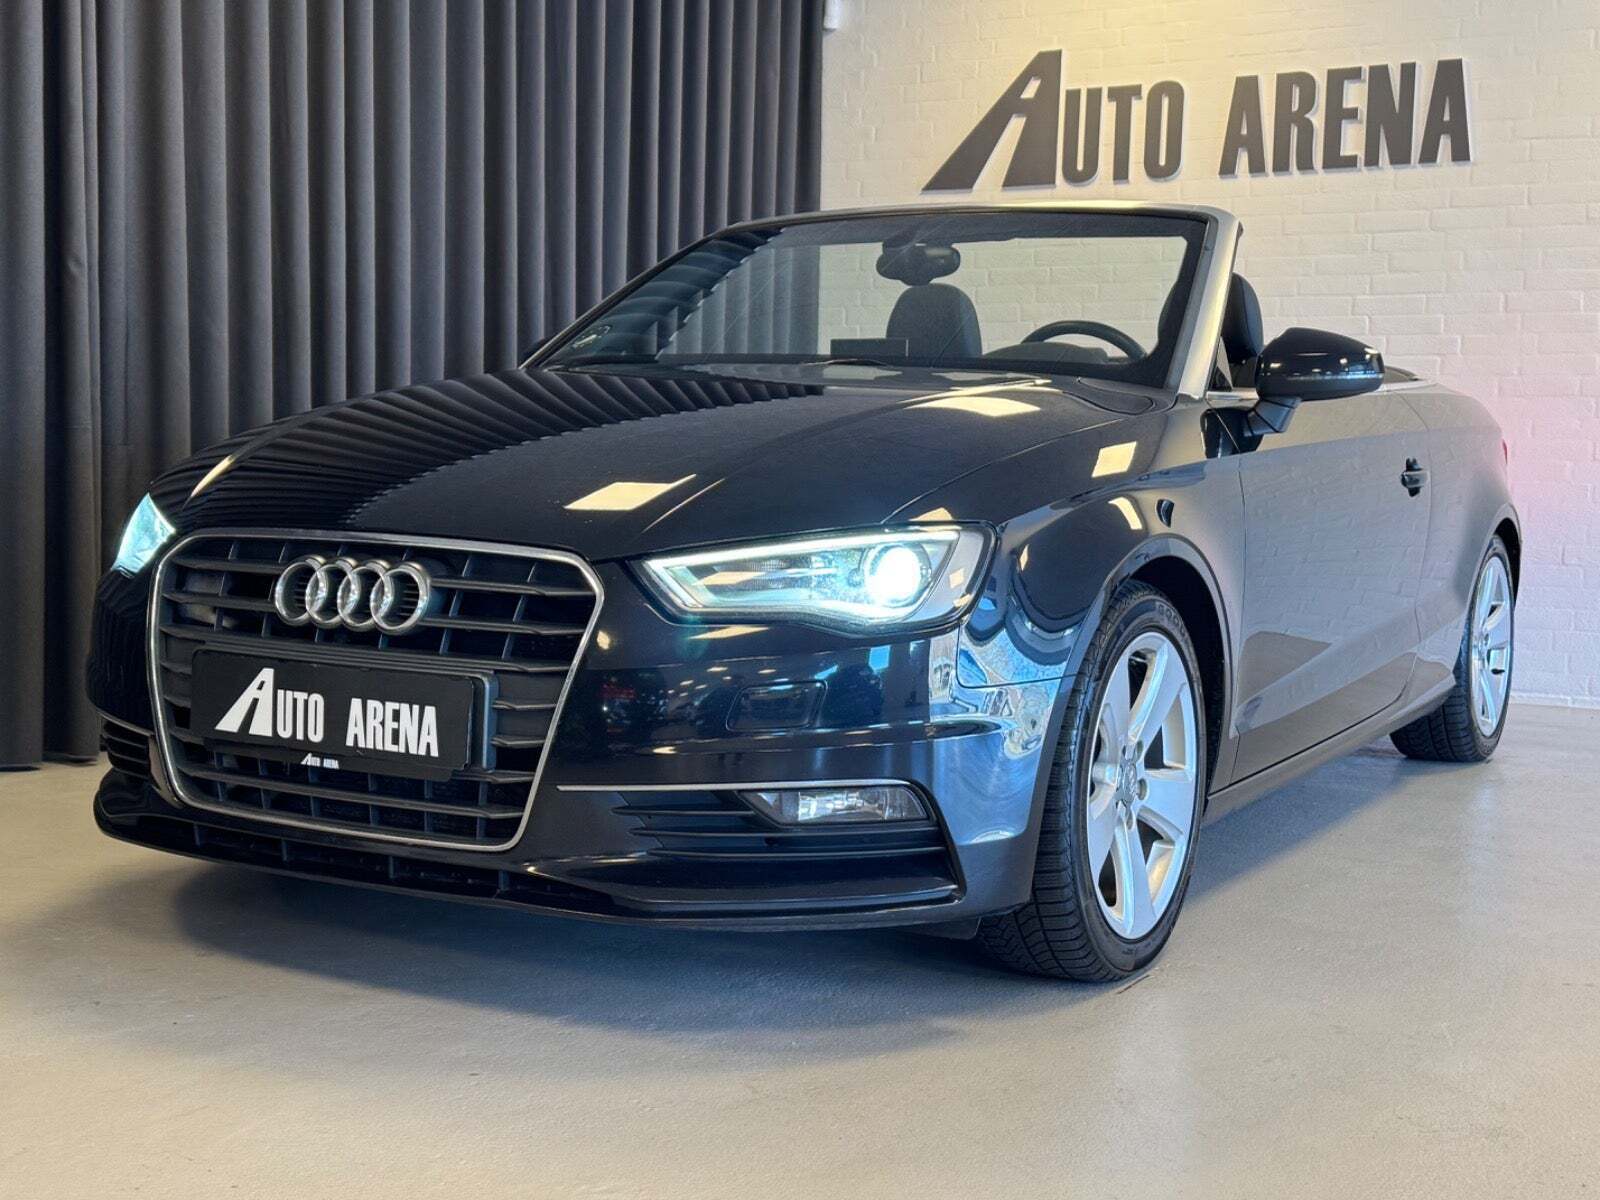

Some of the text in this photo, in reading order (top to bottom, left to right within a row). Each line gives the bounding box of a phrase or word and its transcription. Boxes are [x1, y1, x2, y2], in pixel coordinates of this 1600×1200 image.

[921, 49, 1472, 193] AUTO ARENA
[215, 667, 439, 758] AUTO ARENA
